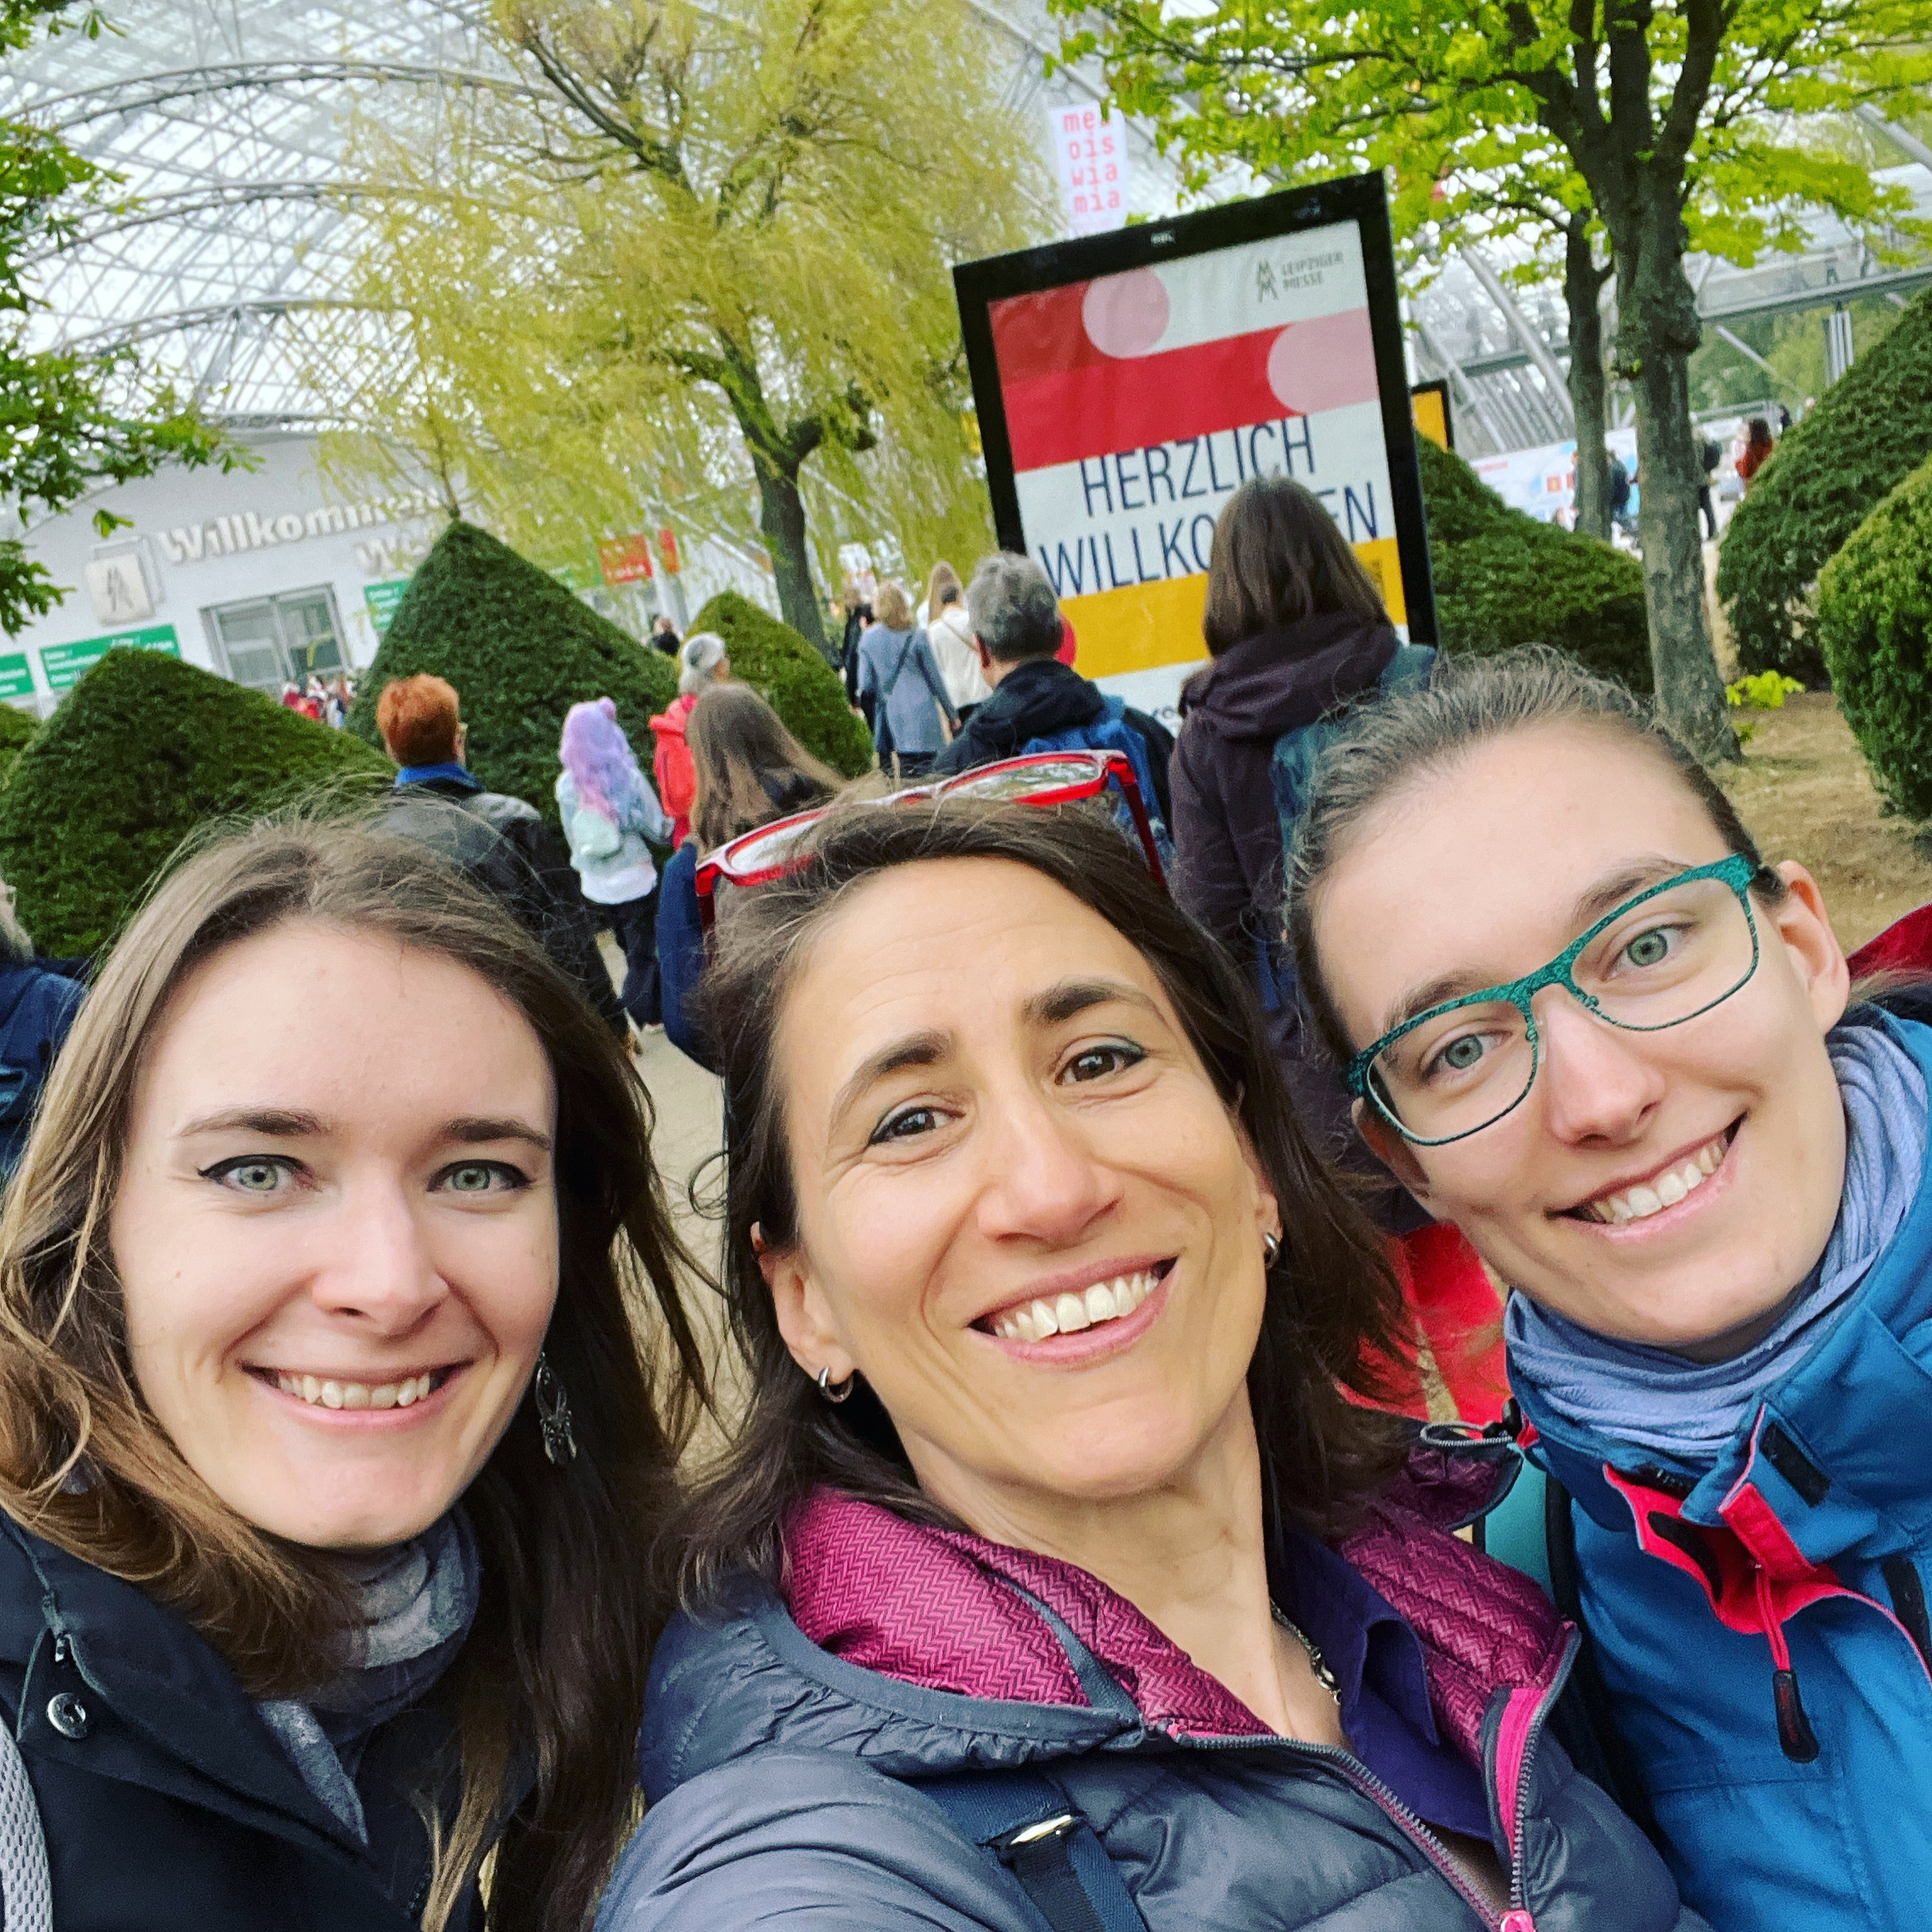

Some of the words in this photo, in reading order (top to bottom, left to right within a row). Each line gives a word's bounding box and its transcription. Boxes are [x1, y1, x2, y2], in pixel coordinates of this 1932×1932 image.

[1063, 110, 1112, 133] me
[1068, 131, 1116, 161] ois
[1071, 158, 1119, 187] wia
[1073, 189, 1121, 214] mia
[1080, 415, 1315, 517] HERZLICH
[1039, 480, 1378, 598] WILLKON
